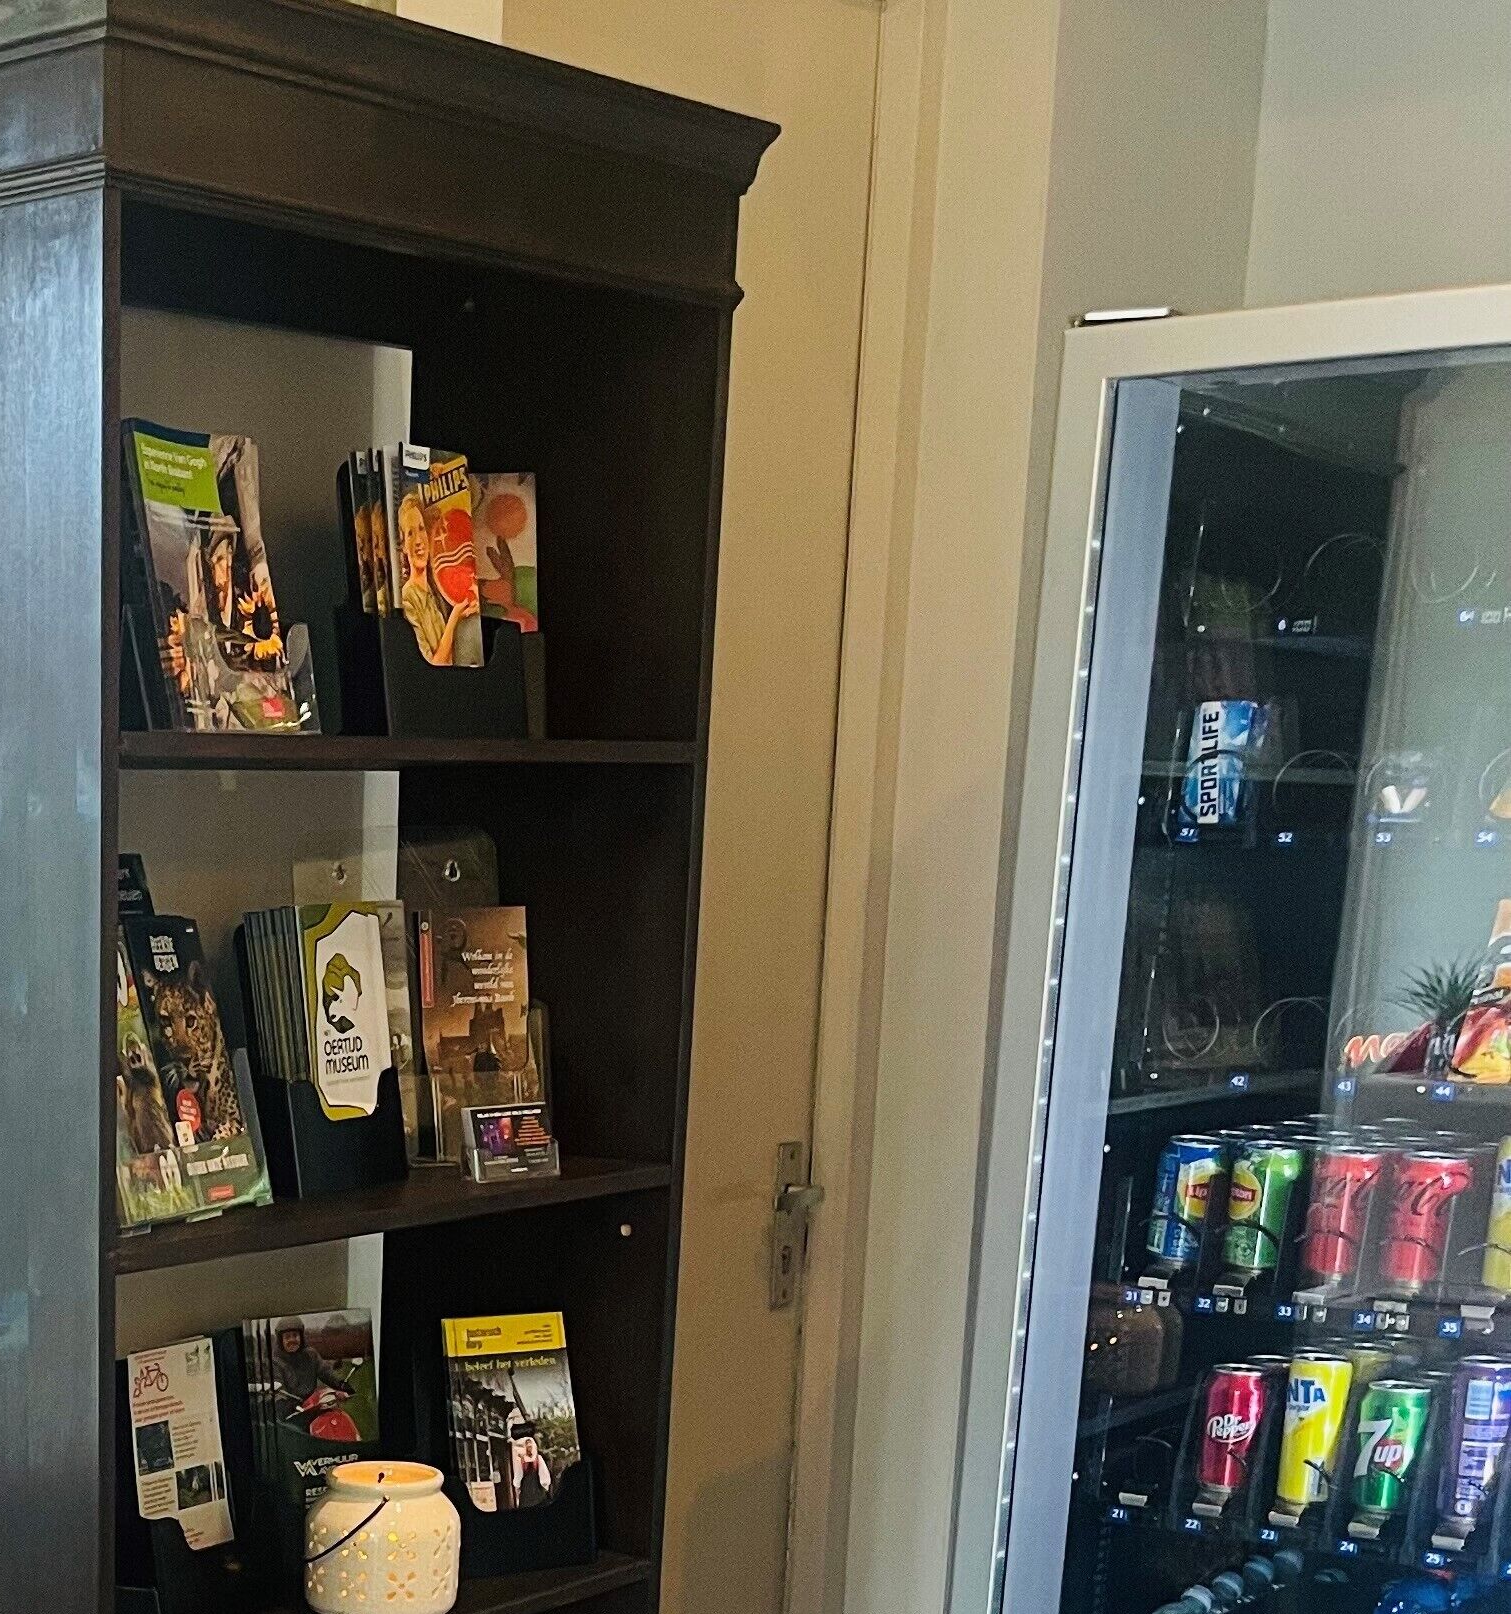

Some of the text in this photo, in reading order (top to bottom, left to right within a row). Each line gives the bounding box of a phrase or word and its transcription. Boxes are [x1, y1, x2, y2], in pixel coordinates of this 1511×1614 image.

[417, 466, 470, 508] PHILIPS
[1125, 1292, 1138, 1302] 31
[1197, 1298, 1211, 1309] 32
[1277, 1305, 1292, 1317] 33
[1356, 1312, 1371, 1325] 34
[1441, 1321, 1457, 1333] 35
[1224, 1413, 1243, 1428] Dr
[1207, 1416, 1255, 1439] Pepper
[1354, 1419, 1403, 1478] 7 up
[1111, 1508, 1124, 1519] 21
[1184, 1518, 1197, 1530] 22
[1261, 1529, 1275, 1541] 23
[1339, 1541, 1354, 1553] 24
[1425, 1552, 1441, 1566] 25
